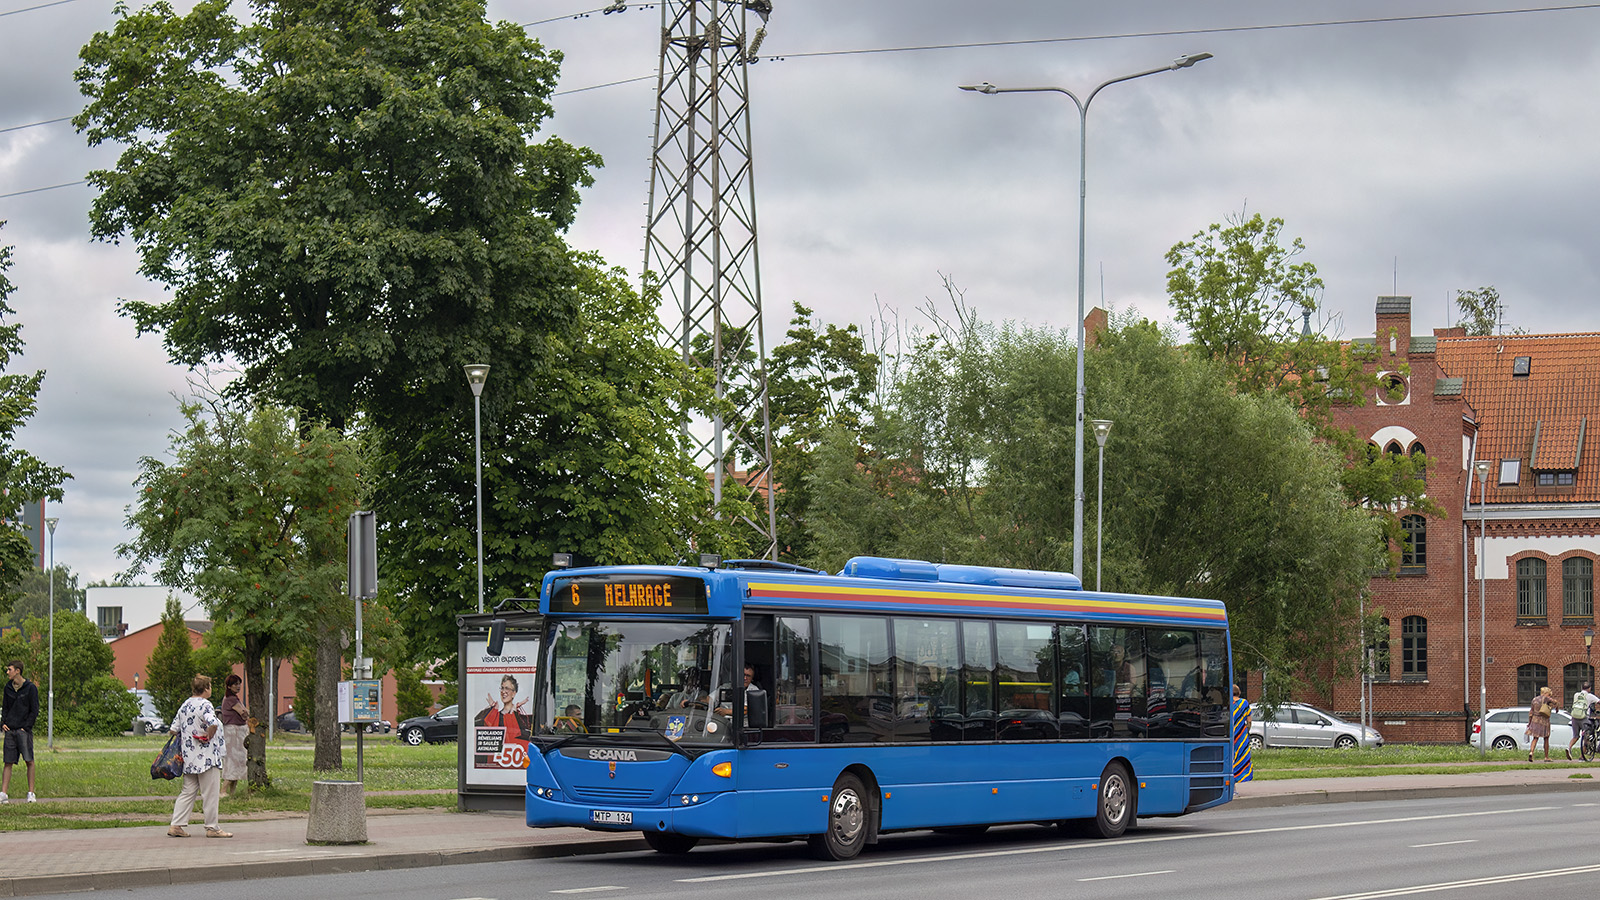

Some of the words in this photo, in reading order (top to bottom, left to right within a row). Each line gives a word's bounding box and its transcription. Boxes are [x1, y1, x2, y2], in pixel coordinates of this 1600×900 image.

[571, 583, 580, 606] 6
[481, 655, 500, 663] vision
[501, 655, 527, 664] express
[589, 749, 637, 761] SCANIA
[595, 811, 611, 821] MTP
[616, 812, 630, 822] 134
